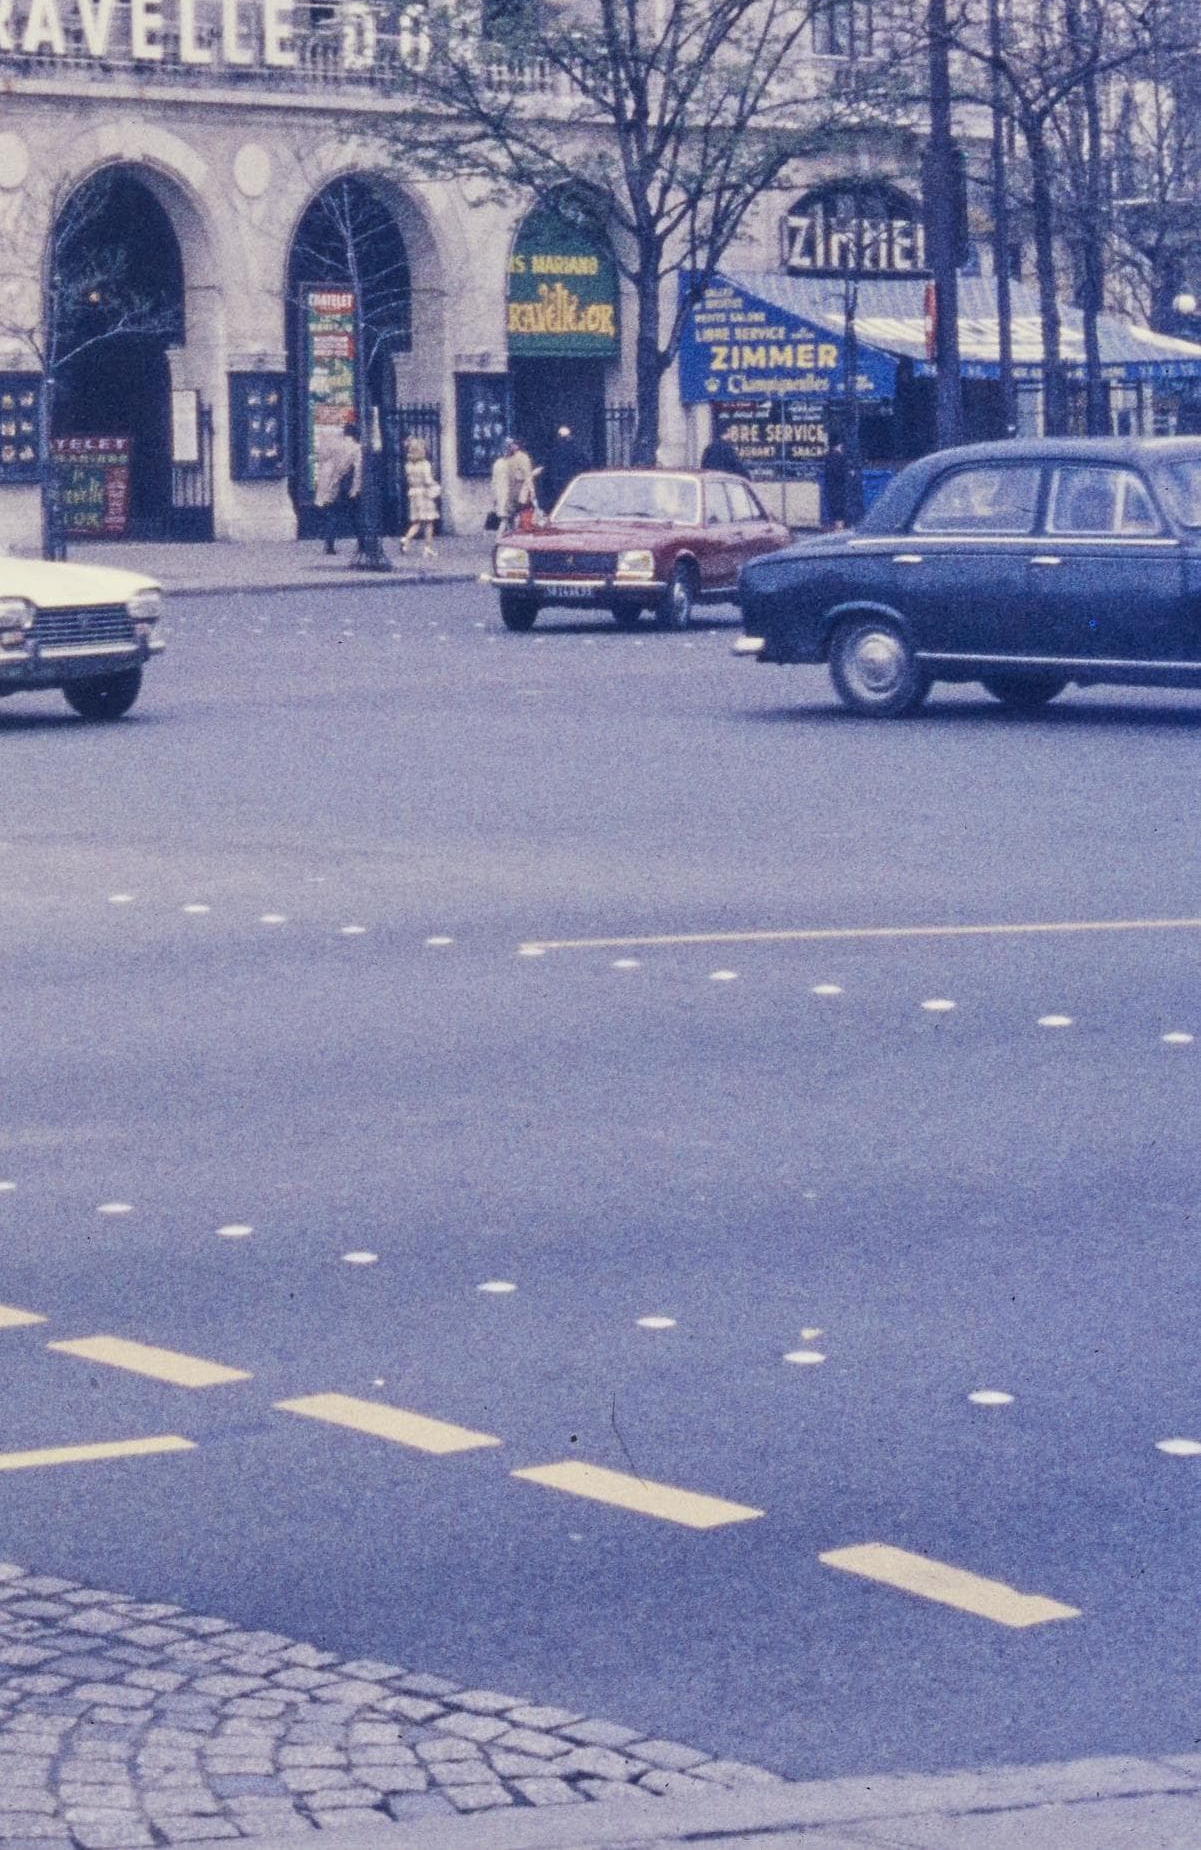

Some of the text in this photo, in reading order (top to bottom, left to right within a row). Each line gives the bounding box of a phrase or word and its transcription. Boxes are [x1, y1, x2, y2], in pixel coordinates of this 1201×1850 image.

[710, 343, 838, 371] ZIMMER
[729, 423, 826, 443] BRE SERVICE
[49, 437, 127, 450] TELET
